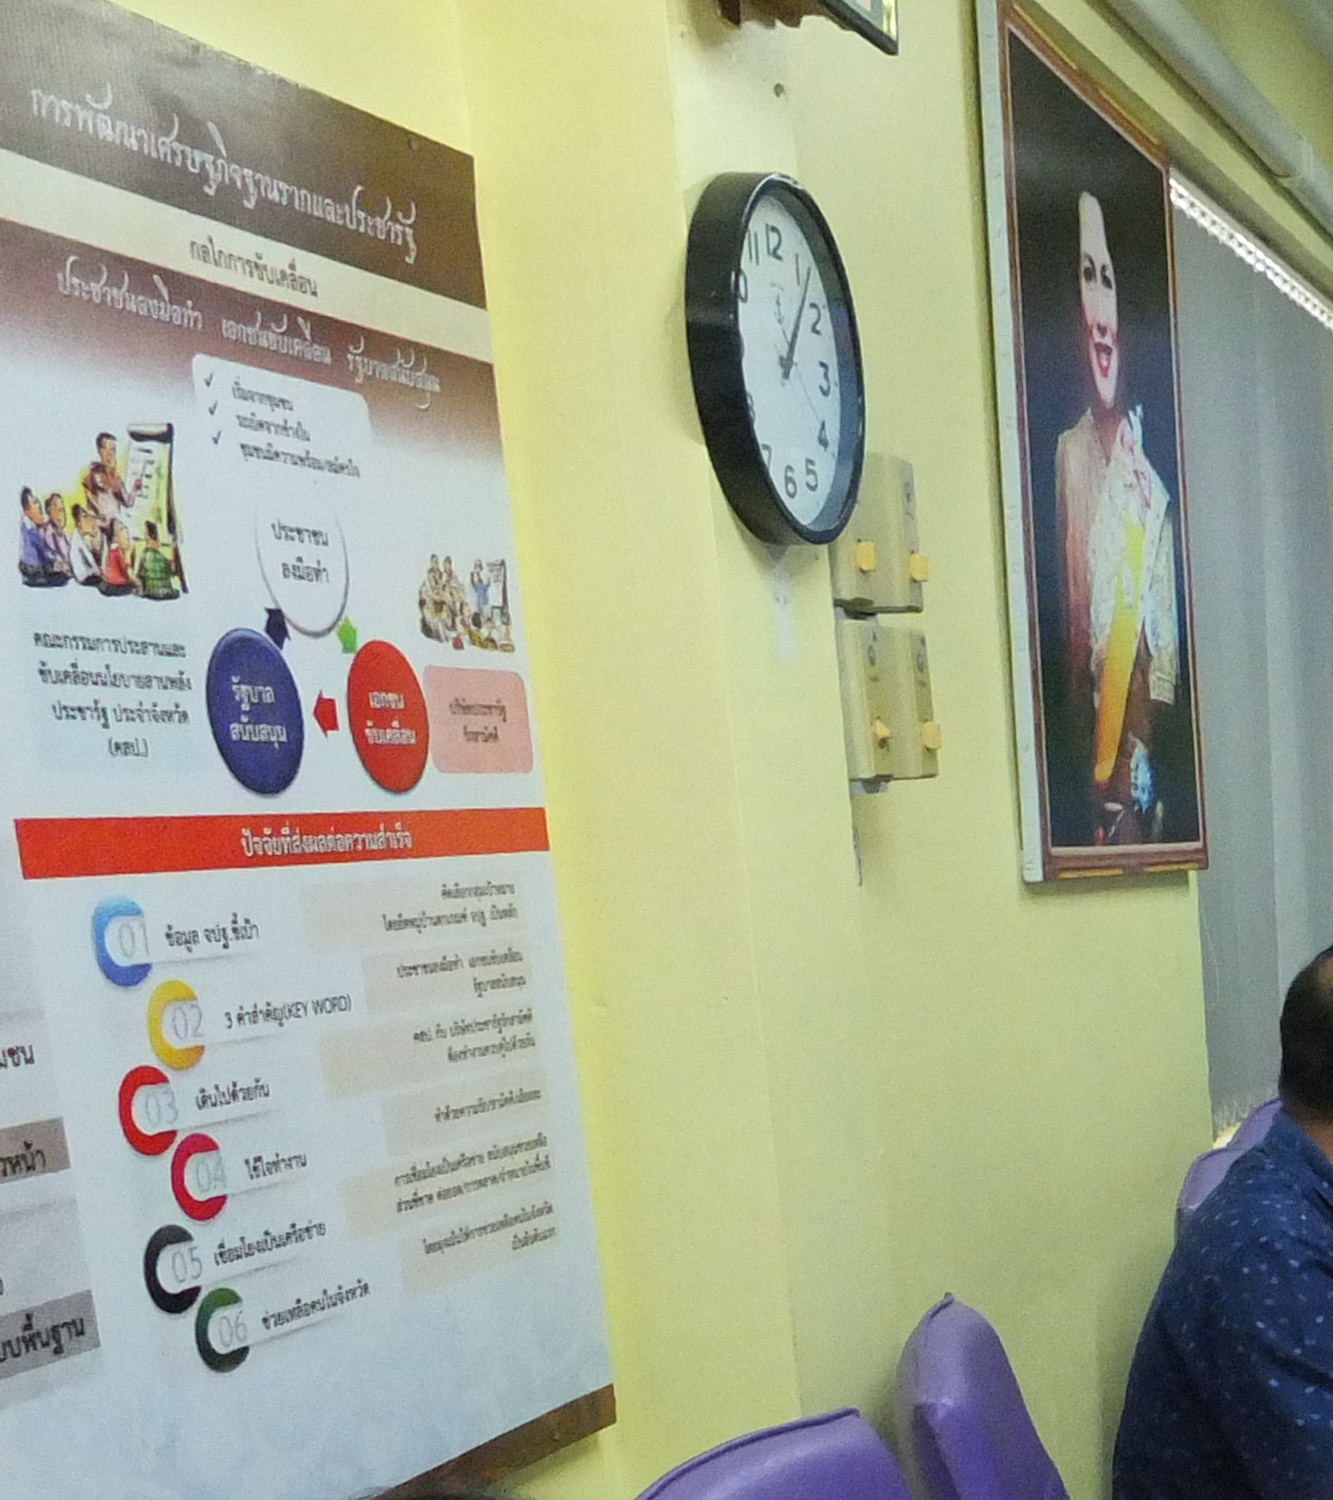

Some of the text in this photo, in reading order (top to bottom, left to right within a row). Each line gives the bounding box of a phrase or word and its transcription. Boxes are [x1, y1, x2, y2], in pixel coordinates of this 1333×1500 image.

[765, 223, 784, 262] 12
[809, 302, 822, 336] 2
[818, 360, 832, 398] 3
[817, 419, 830, 452] 4
[783, 464, 798, 499] 6
[805, 457, 819, 492] 5
